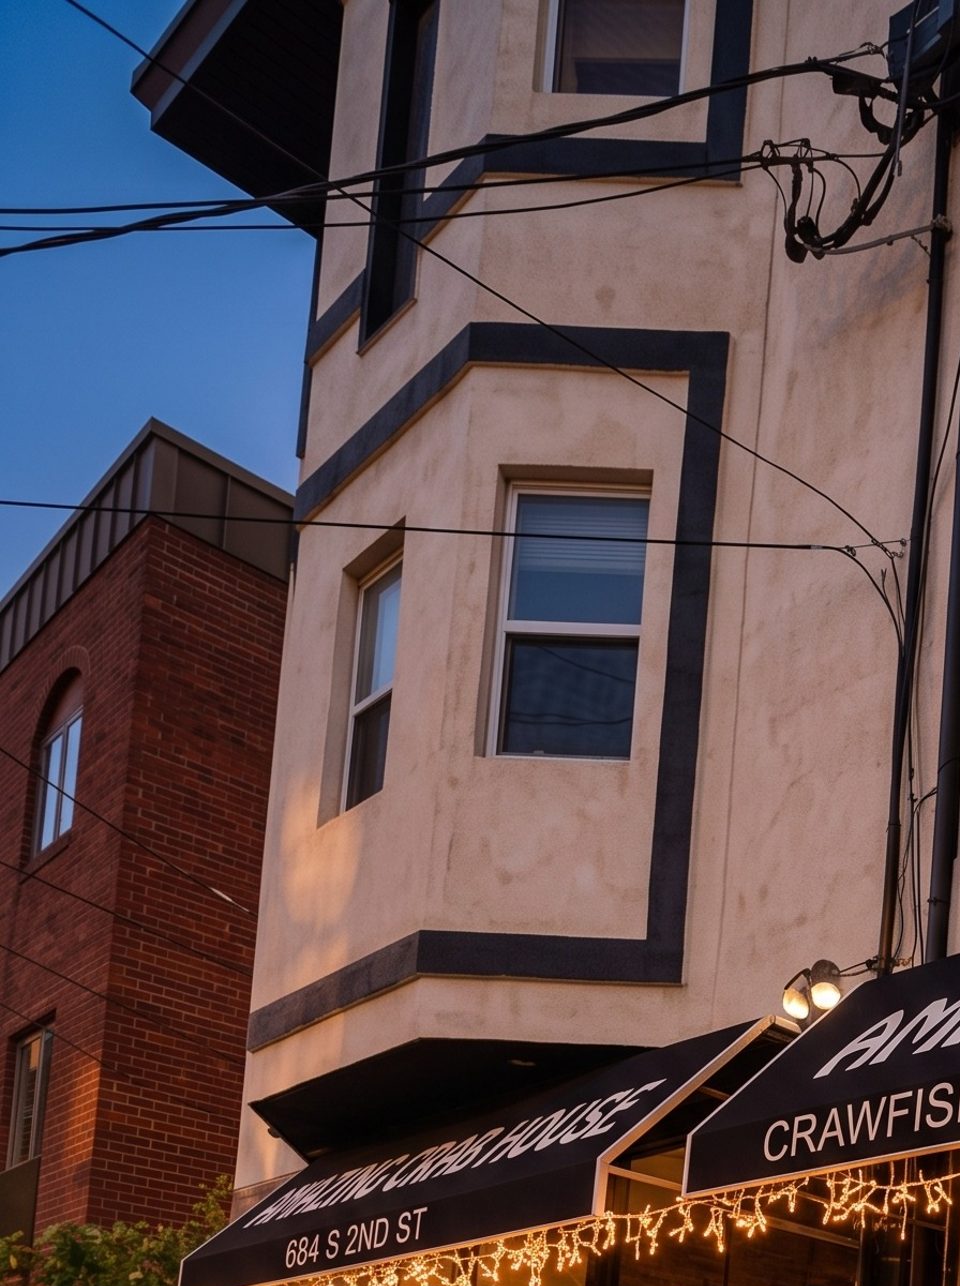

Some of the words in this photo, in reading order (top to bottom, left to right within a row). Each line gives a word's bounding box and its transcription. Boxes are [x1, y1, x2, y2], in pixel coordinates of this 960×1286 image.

[242, 1153, 411, 1229] AMAZING
[381, 1126, 506, 1193] CRAB
[470, 1078, 668, 1169] HOUSE
[284, 1233, 319, 1269] 684
[326, 1229, 340, 1260] S
[344, 1217, 389, 1253] 2ND
[395, 1206, 429, 1245] ST
